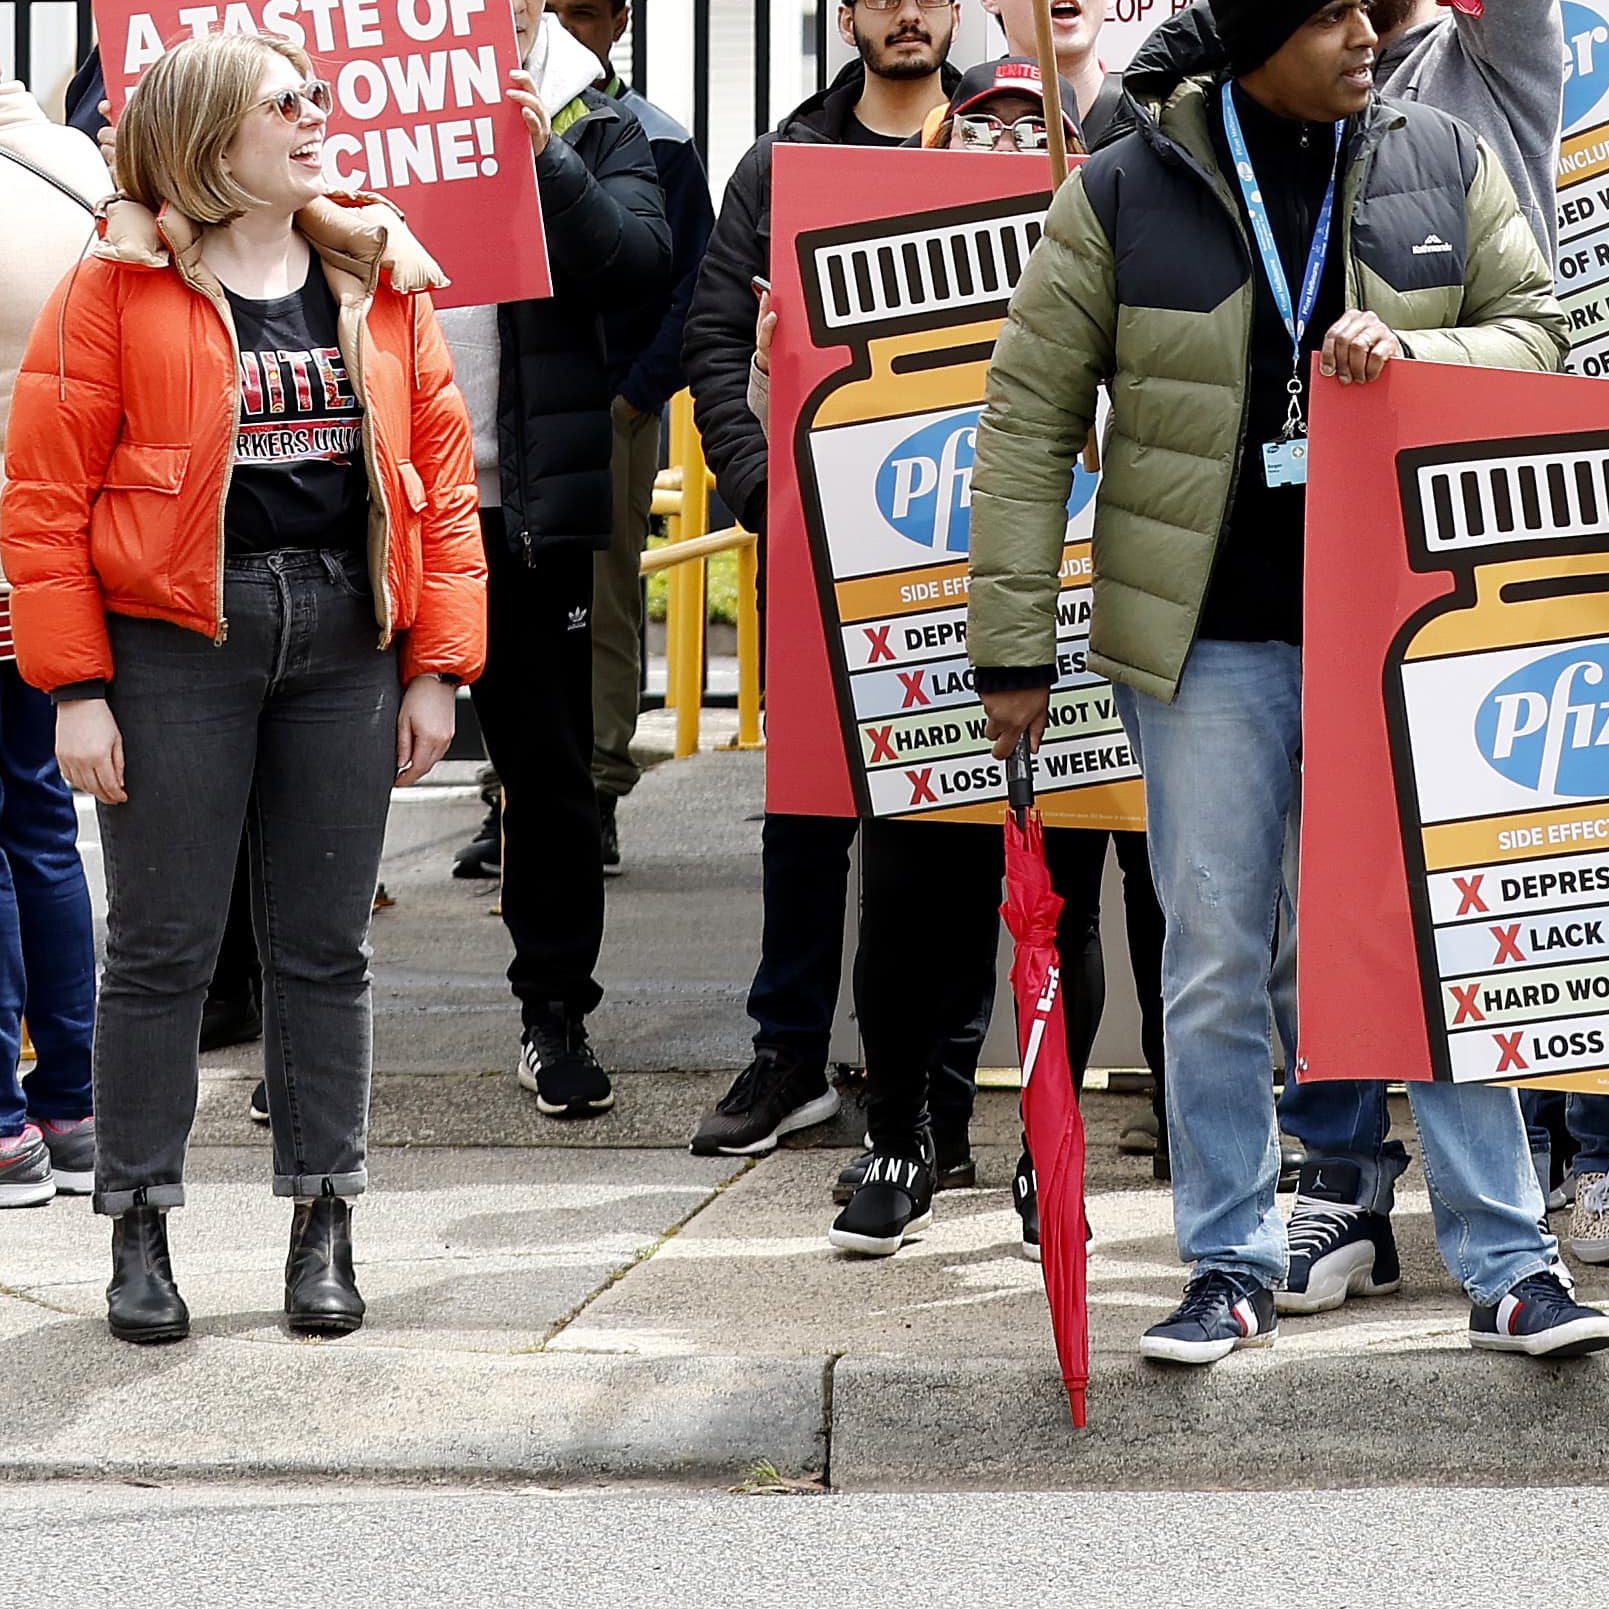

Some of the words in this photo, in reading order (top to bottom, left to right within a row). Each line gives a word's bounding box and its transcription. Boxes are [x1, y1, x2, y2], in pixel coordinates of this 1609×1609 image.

[124, 14, 165, 74] A
[337, 46, 502, 120] OWN
[995, 64, 1041, 79] UNITE
[320, 117, 498, 191] CINE!
[1559, 251, 1590, 280] OF
[239, 347, 355, 416] NITE
[236, 429, 309, 458] RKERS
[900, 582, 939, 603] SIDE
[932, 670, 976, 696] LAC
[894, 724, 961, 753] HARD
[940, 766, 1001, 794] LOSS
[1046, 745, 1137, 778] WEEKE
[1497, 827, 1543, 851] SIDE
[1530, 920, 1604, 952] LACK
[1483, 983, 1560, 1012] HARD
[1533, 1030, 1604, 1061] LOSS
